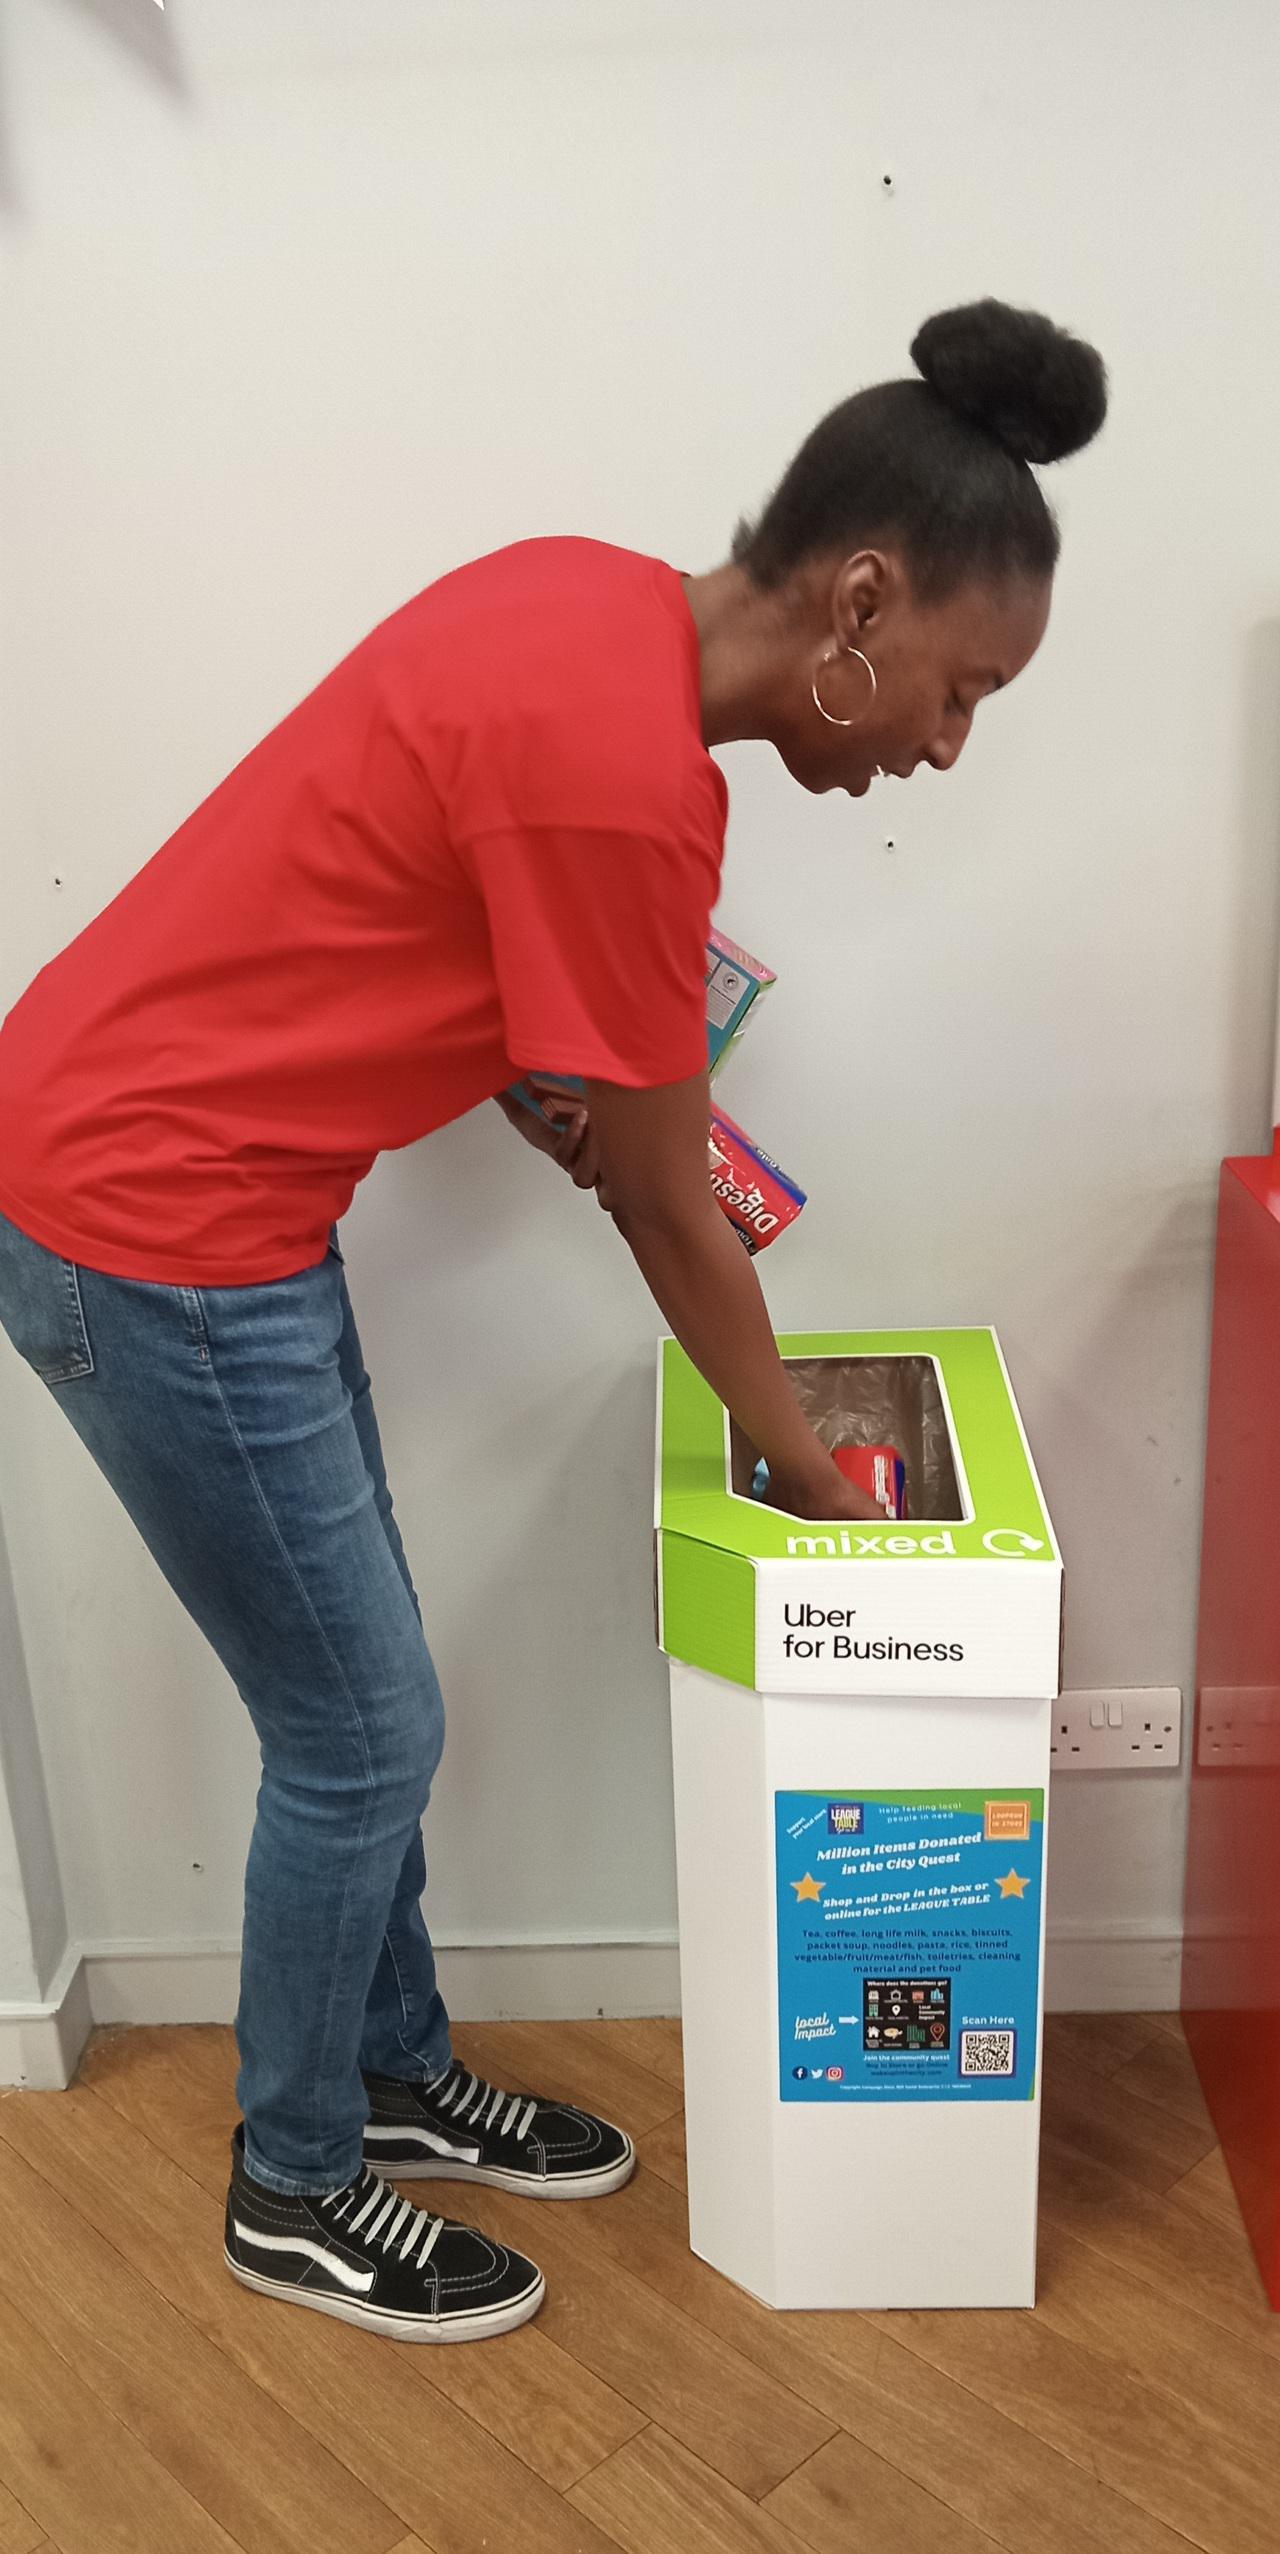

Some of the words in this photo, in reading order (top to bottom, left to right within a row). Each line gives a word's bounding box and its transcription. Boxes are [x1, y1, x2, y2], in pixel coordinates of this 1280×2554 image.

[786, 1530, 956, 1555] mixed
[784, 1604, 856, 1627] Uber
[783, 1634, 825, 1658] for
[834, 1635, 964, 1661] Business
[902, 1804, 936, 1812] feeding
[887, 1815, 917, 1824] people
[817, 1846, 870, 1861] Million
[873, 1842, 916, 1855] Items
[919, 1832, 982, 1850] Donated
[842, 1864, 857, 1875] in
[860, 1861, 883, 1873] the
[886, 1858, 916, 1870] City
[918, 1852, 960, 1868] Quest
[823, 1898, 853, 1908] Shop
[856, 1894, 878, 1904] and
[881, 1891, 910, 1902] Drop
[914, 1888, 925, 1897] in
[929, 1886, 948, 1896] the
[950, 1884, 972, 1894] box
[825, 1908, 862, 1920] online
[863, 1907, 881, 1917] for
[883, 1905, 902, 1914] the
[903, 1899, 950, 1912] LEAGUE
[952, 1894, 991, 1907] TABLE
[862, 1929, 884, 1939] long
[886, 1929, 902, 1937] life
[905, 1929, 928, 1938] milk,
[807, 1942, 840, 1950] packet
[843, 1943, 870, 1951] soup,
[873, 1941, 915, 1950] noodles,
[975, 1941, 1008, 1949] tinned
[978, 1952, 1021, 1961] cleaning
[853, 1965, 896, 1973] material
[920, 1965, 936, 1973] pet
[962, 2016, 987, 2024] Scan
[989, 2016, 1014, 2024] Here
[794, 2023, 836, 2041] Impact
